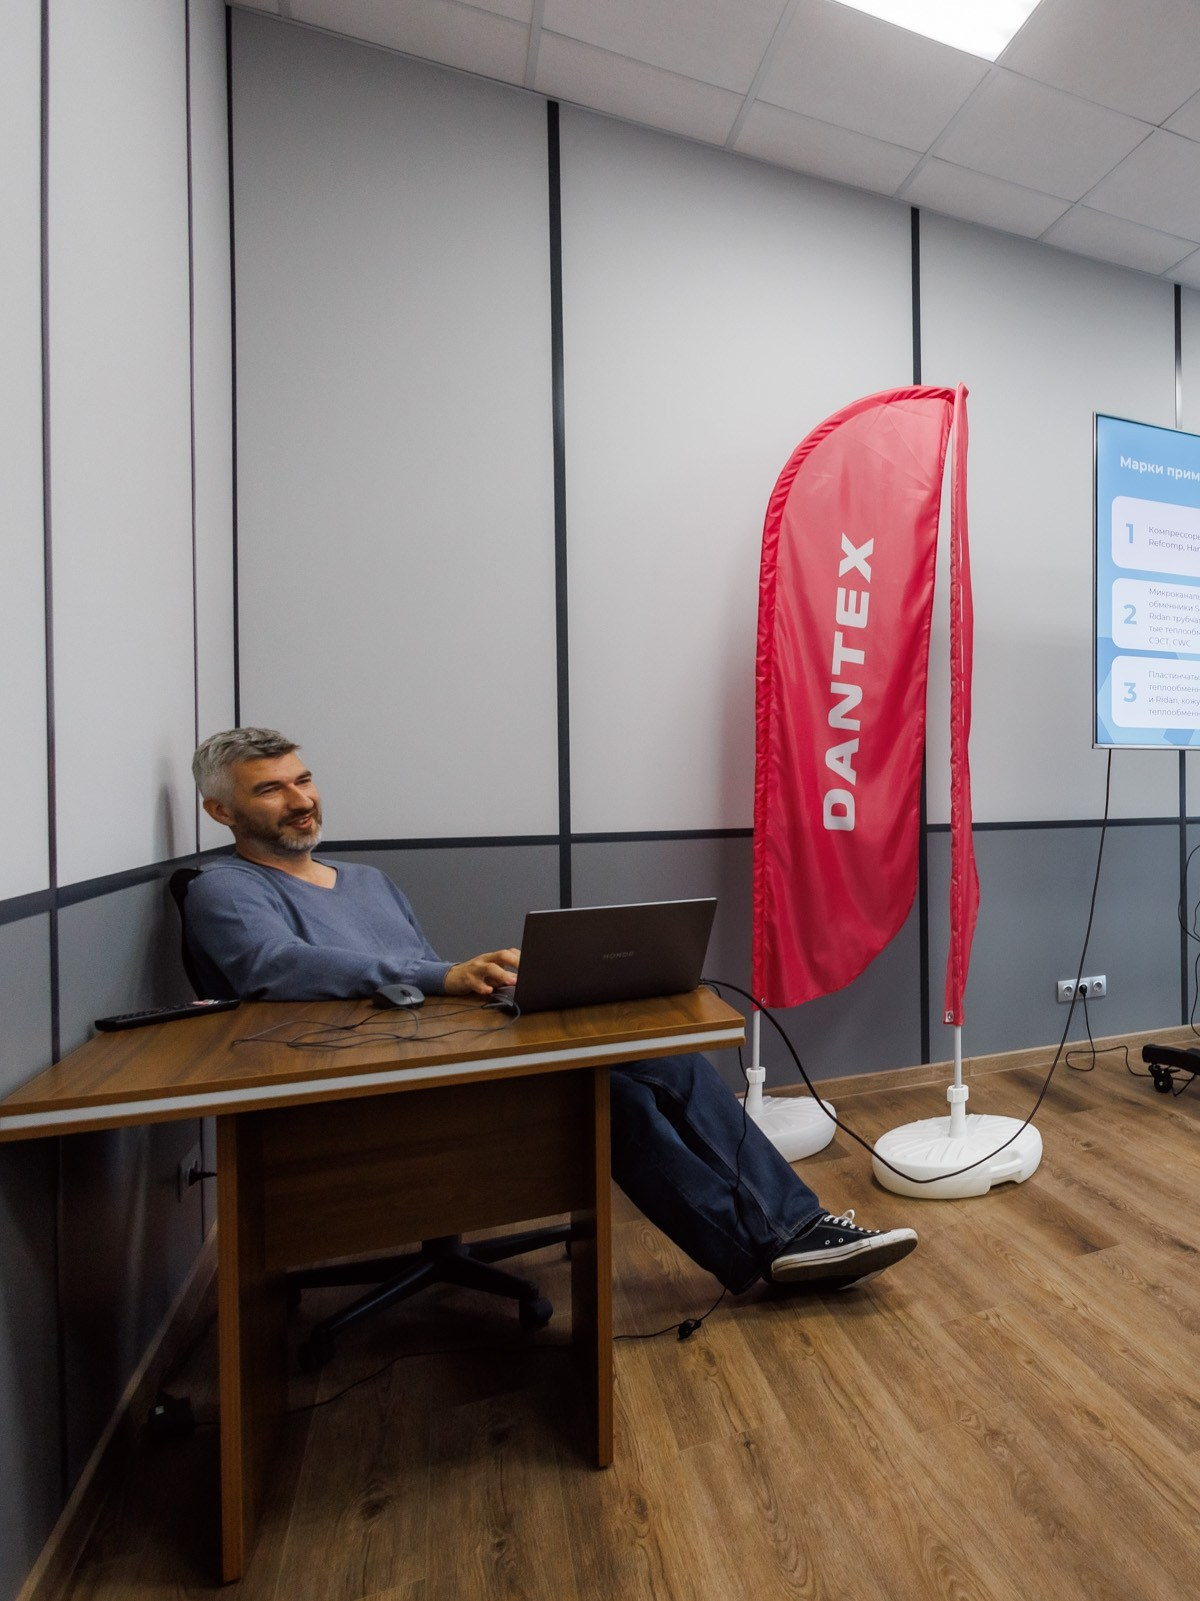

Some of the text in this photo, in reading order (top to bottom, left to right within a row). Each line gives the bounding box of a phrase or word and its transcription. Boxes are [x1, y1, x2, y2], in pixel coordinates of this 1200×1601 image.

[1120, 455, 1164, 474] Марки
[1125, 522, 1134, 544] 1
[1148, 538, 1185, 552] Refcomp,
[1123, 603, 1138, 625] 2
[1148, 600, 1194, 611] обменники
[1148, 612, 1171, 622] Ridan
[1148, 625, 1164, 633] тые
[823, 532, 874, 832] DANTEX
[1123, 682, 1137, 703] 3
